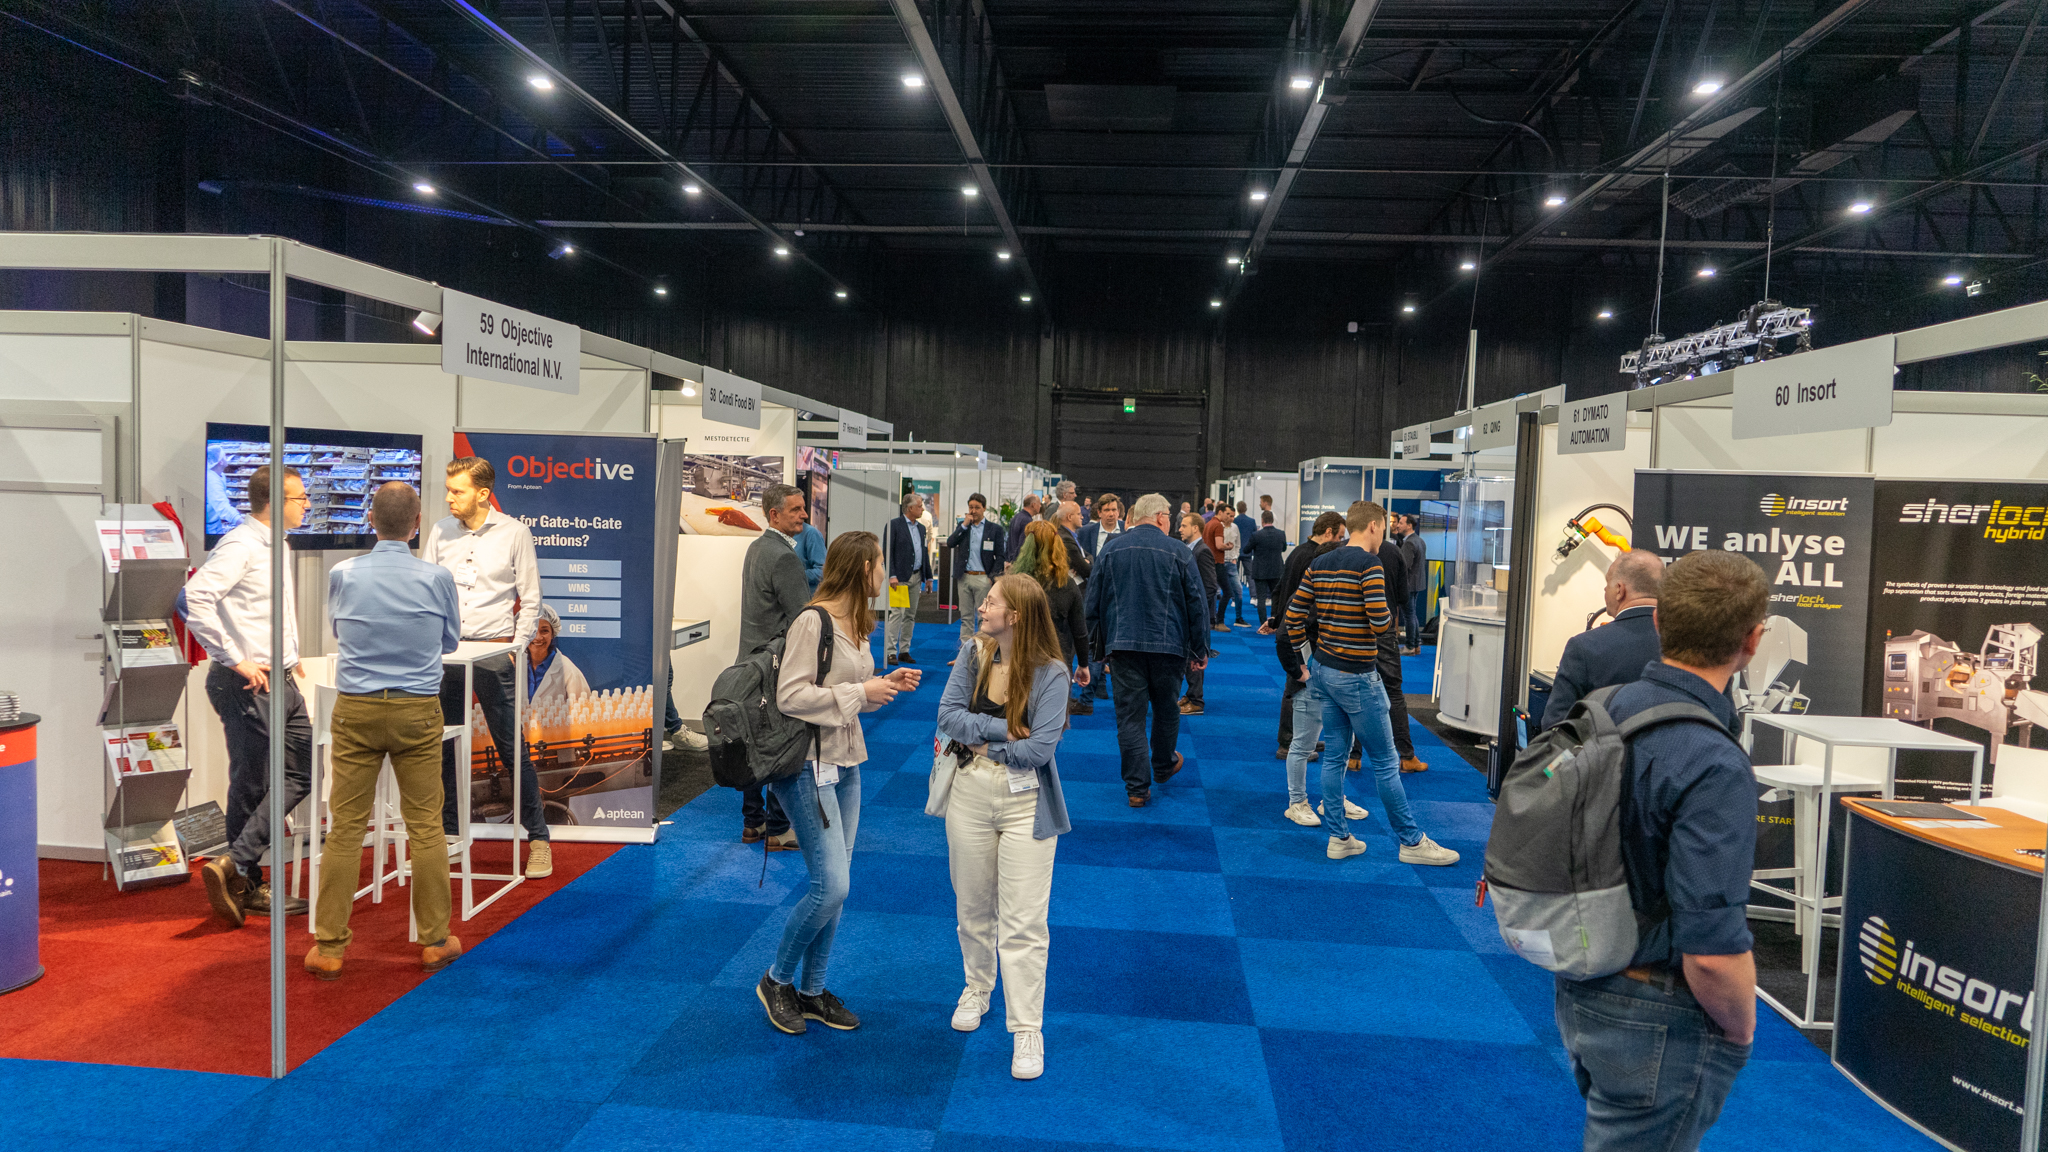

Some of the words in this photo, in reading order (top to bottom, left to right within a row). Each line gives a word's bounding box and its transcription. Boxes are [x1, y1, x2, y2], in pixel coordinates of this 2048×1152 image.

[480, 312, 494, 335] 59
[501, 318, 553, 348] Objective
[466, 342, 540, 376] International
[543, 358, 563, 380] N.V.
[709, 387, 717, 402] 58
[718, 390, 733, 406] Condi
[734, 394, 747, 409] Food
[748, 397, 756, 411] BV
[1775, 386, 1790, 406] 60
[1797, 378, 1837, 403] Insort
[1573, 408, 1580, 423] 61
[1582, 404, 1609, 422] DYMATO
[1570, 428, 1610, 445] AUTOMATION
[507, 455, 635, 483] Objective
[1787, 496, 1849, 510] insort
[520, 514, 538, 528] for
[540, 514, 622, 530] Gate-to-Gate
[533, 534, 590, 548] erations?
[1655, 525, 1708, 550] WE
[1723, 527, 1846, 560] anlyse
[1983, 526, 2046, 543] hybrid
[568, 564, 588, 574] MES
[1774, 561, 1844, 588] ALL
[568, 583, 590, 593] WMS
[1770, 592, 1824, 604] sherlock
[568, 604, 588, 613] EAM
[569, 624, 586, 633] OEE
[606, 809, 644, 821] aptean
[1896, 978, 1956, 1018] intelligent
[1960, 1012, 2030, 1048] selection
[1952, 1076, 2025, 1116] www.insort.a
